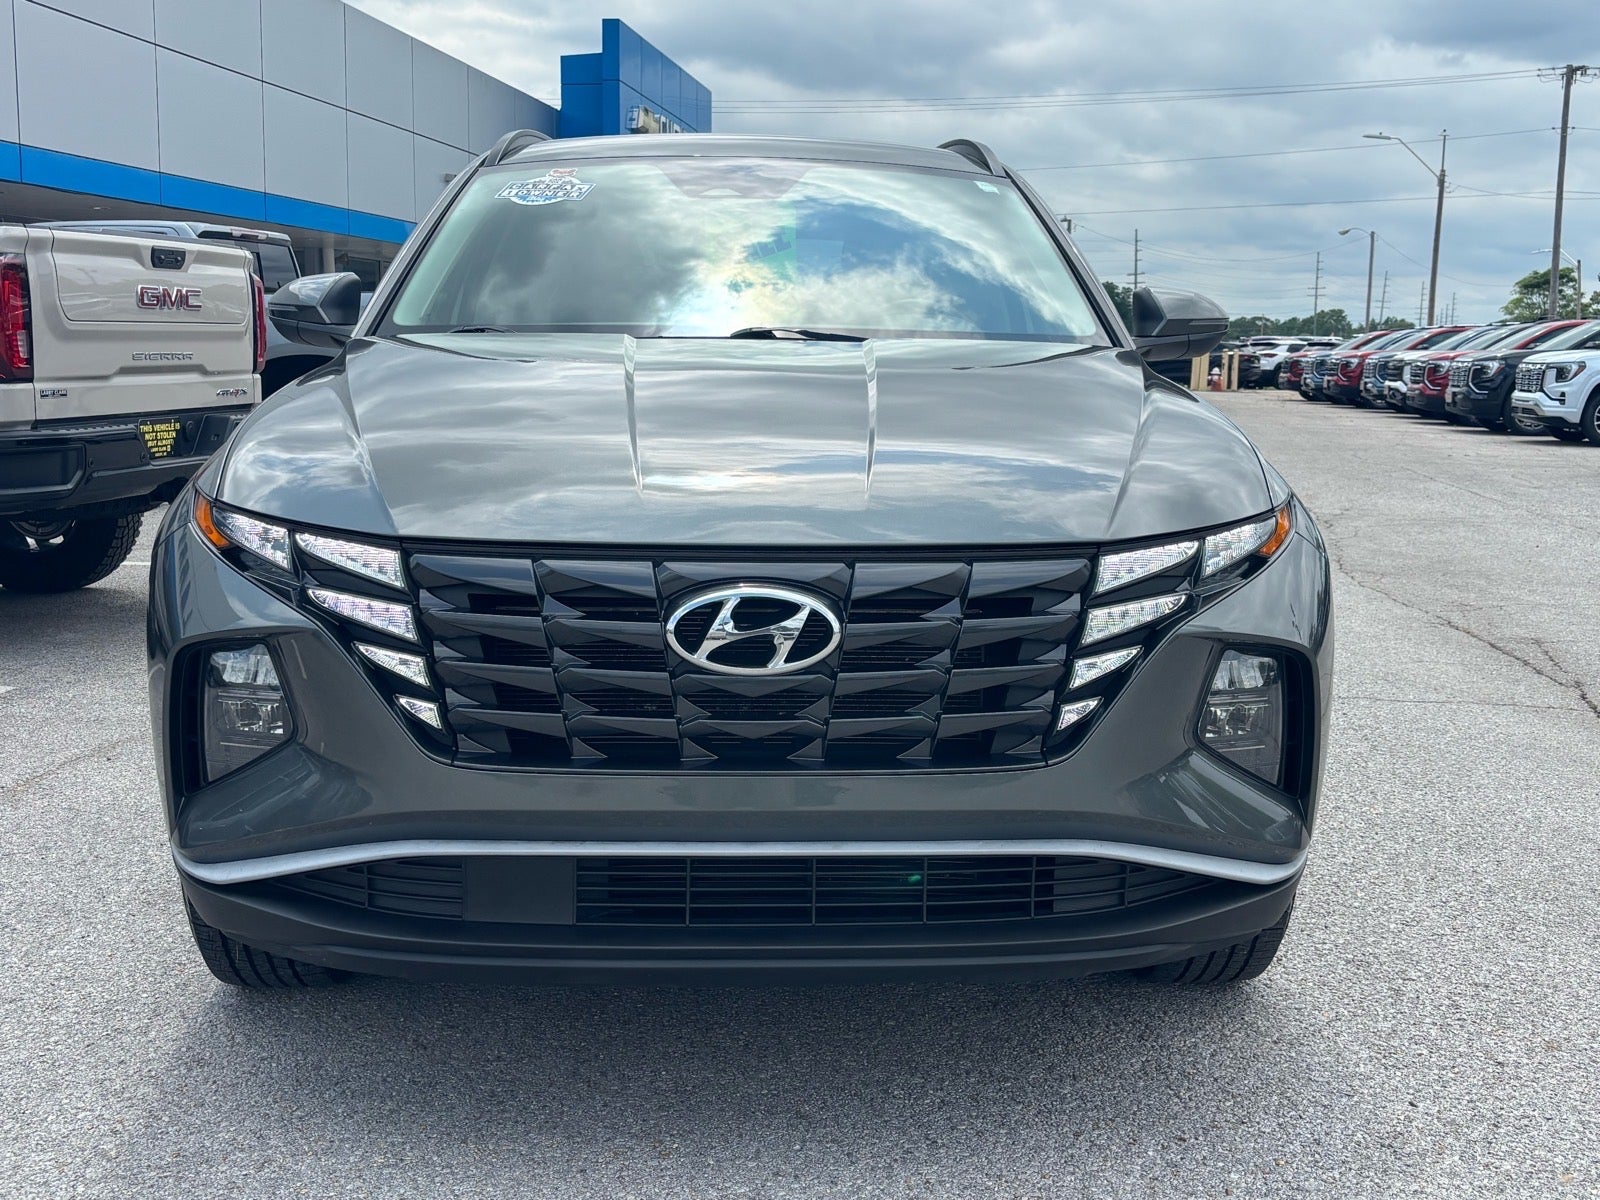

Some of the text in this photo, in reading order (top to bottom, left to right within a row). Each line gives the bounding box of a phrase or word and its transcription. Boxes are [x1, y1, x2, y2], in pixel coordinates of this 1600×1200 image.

[511, 183, 586, 192] CARFAX
[136, 284, 202, 311] GMC
[132, 352, 194, 361] SIERRA
[139, 422, 181, 433] THIS VEHICLE IS
[144, 431, 176, 440] NOT STOLEN
